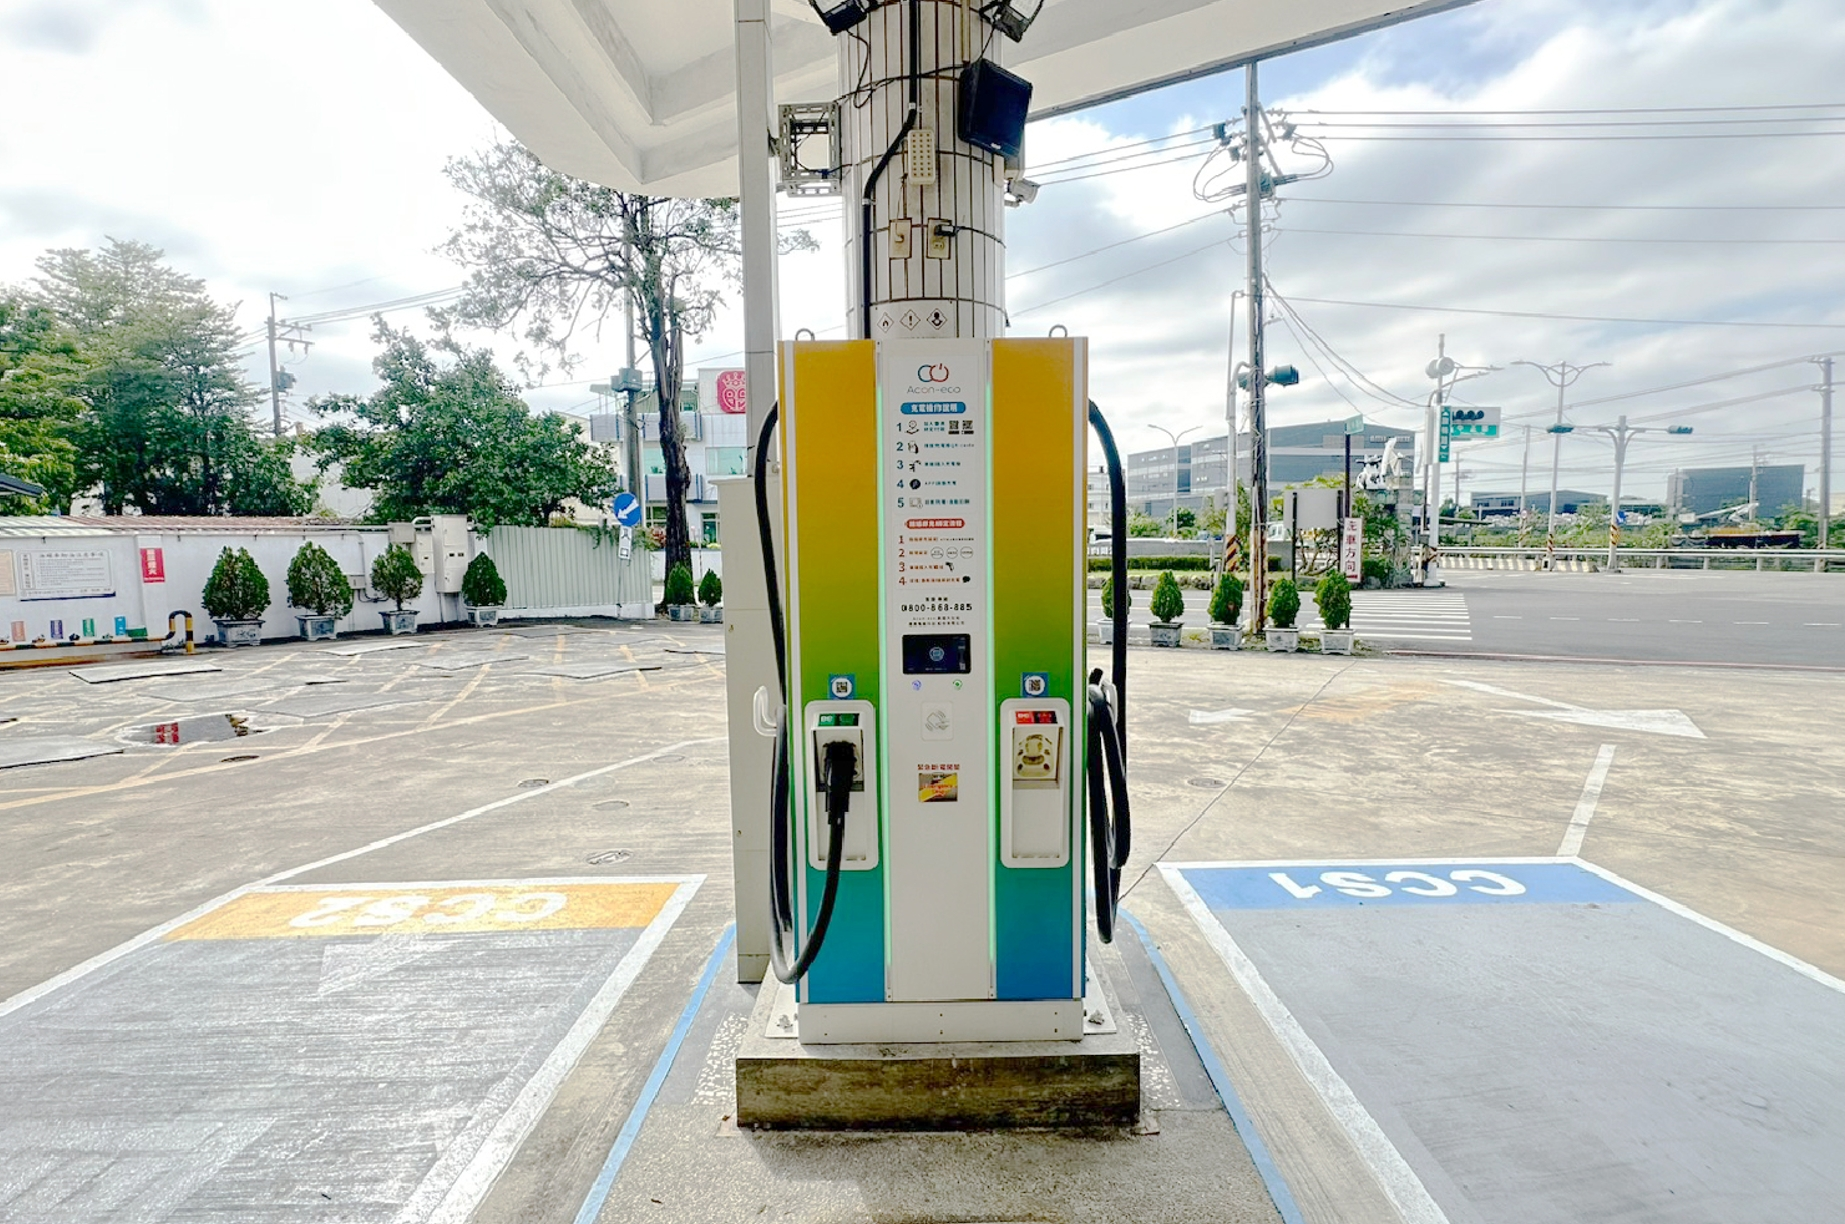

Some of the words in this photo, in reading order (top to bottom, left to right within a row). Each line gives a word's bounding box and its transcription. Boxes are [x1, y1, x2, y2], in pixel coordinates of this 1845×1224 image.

[906, 385, 961, 394] Acon-eco
[896, 422, 902, 432] 1
[896, 441, 904, 452] 2
[896, 460, 904, 470] 3
[896, 479, 904, 489] 4
[897, 497, 905, 508] 5
[898, 535, 905, 544] 1
[898, 548, 905, 557] 2
[898, 562, 905, 572] 3
[898, 576, 906, 586] 4
[1268, 869, 1526, 899] CCS1
[289, 892, 567, 928] CCS2
